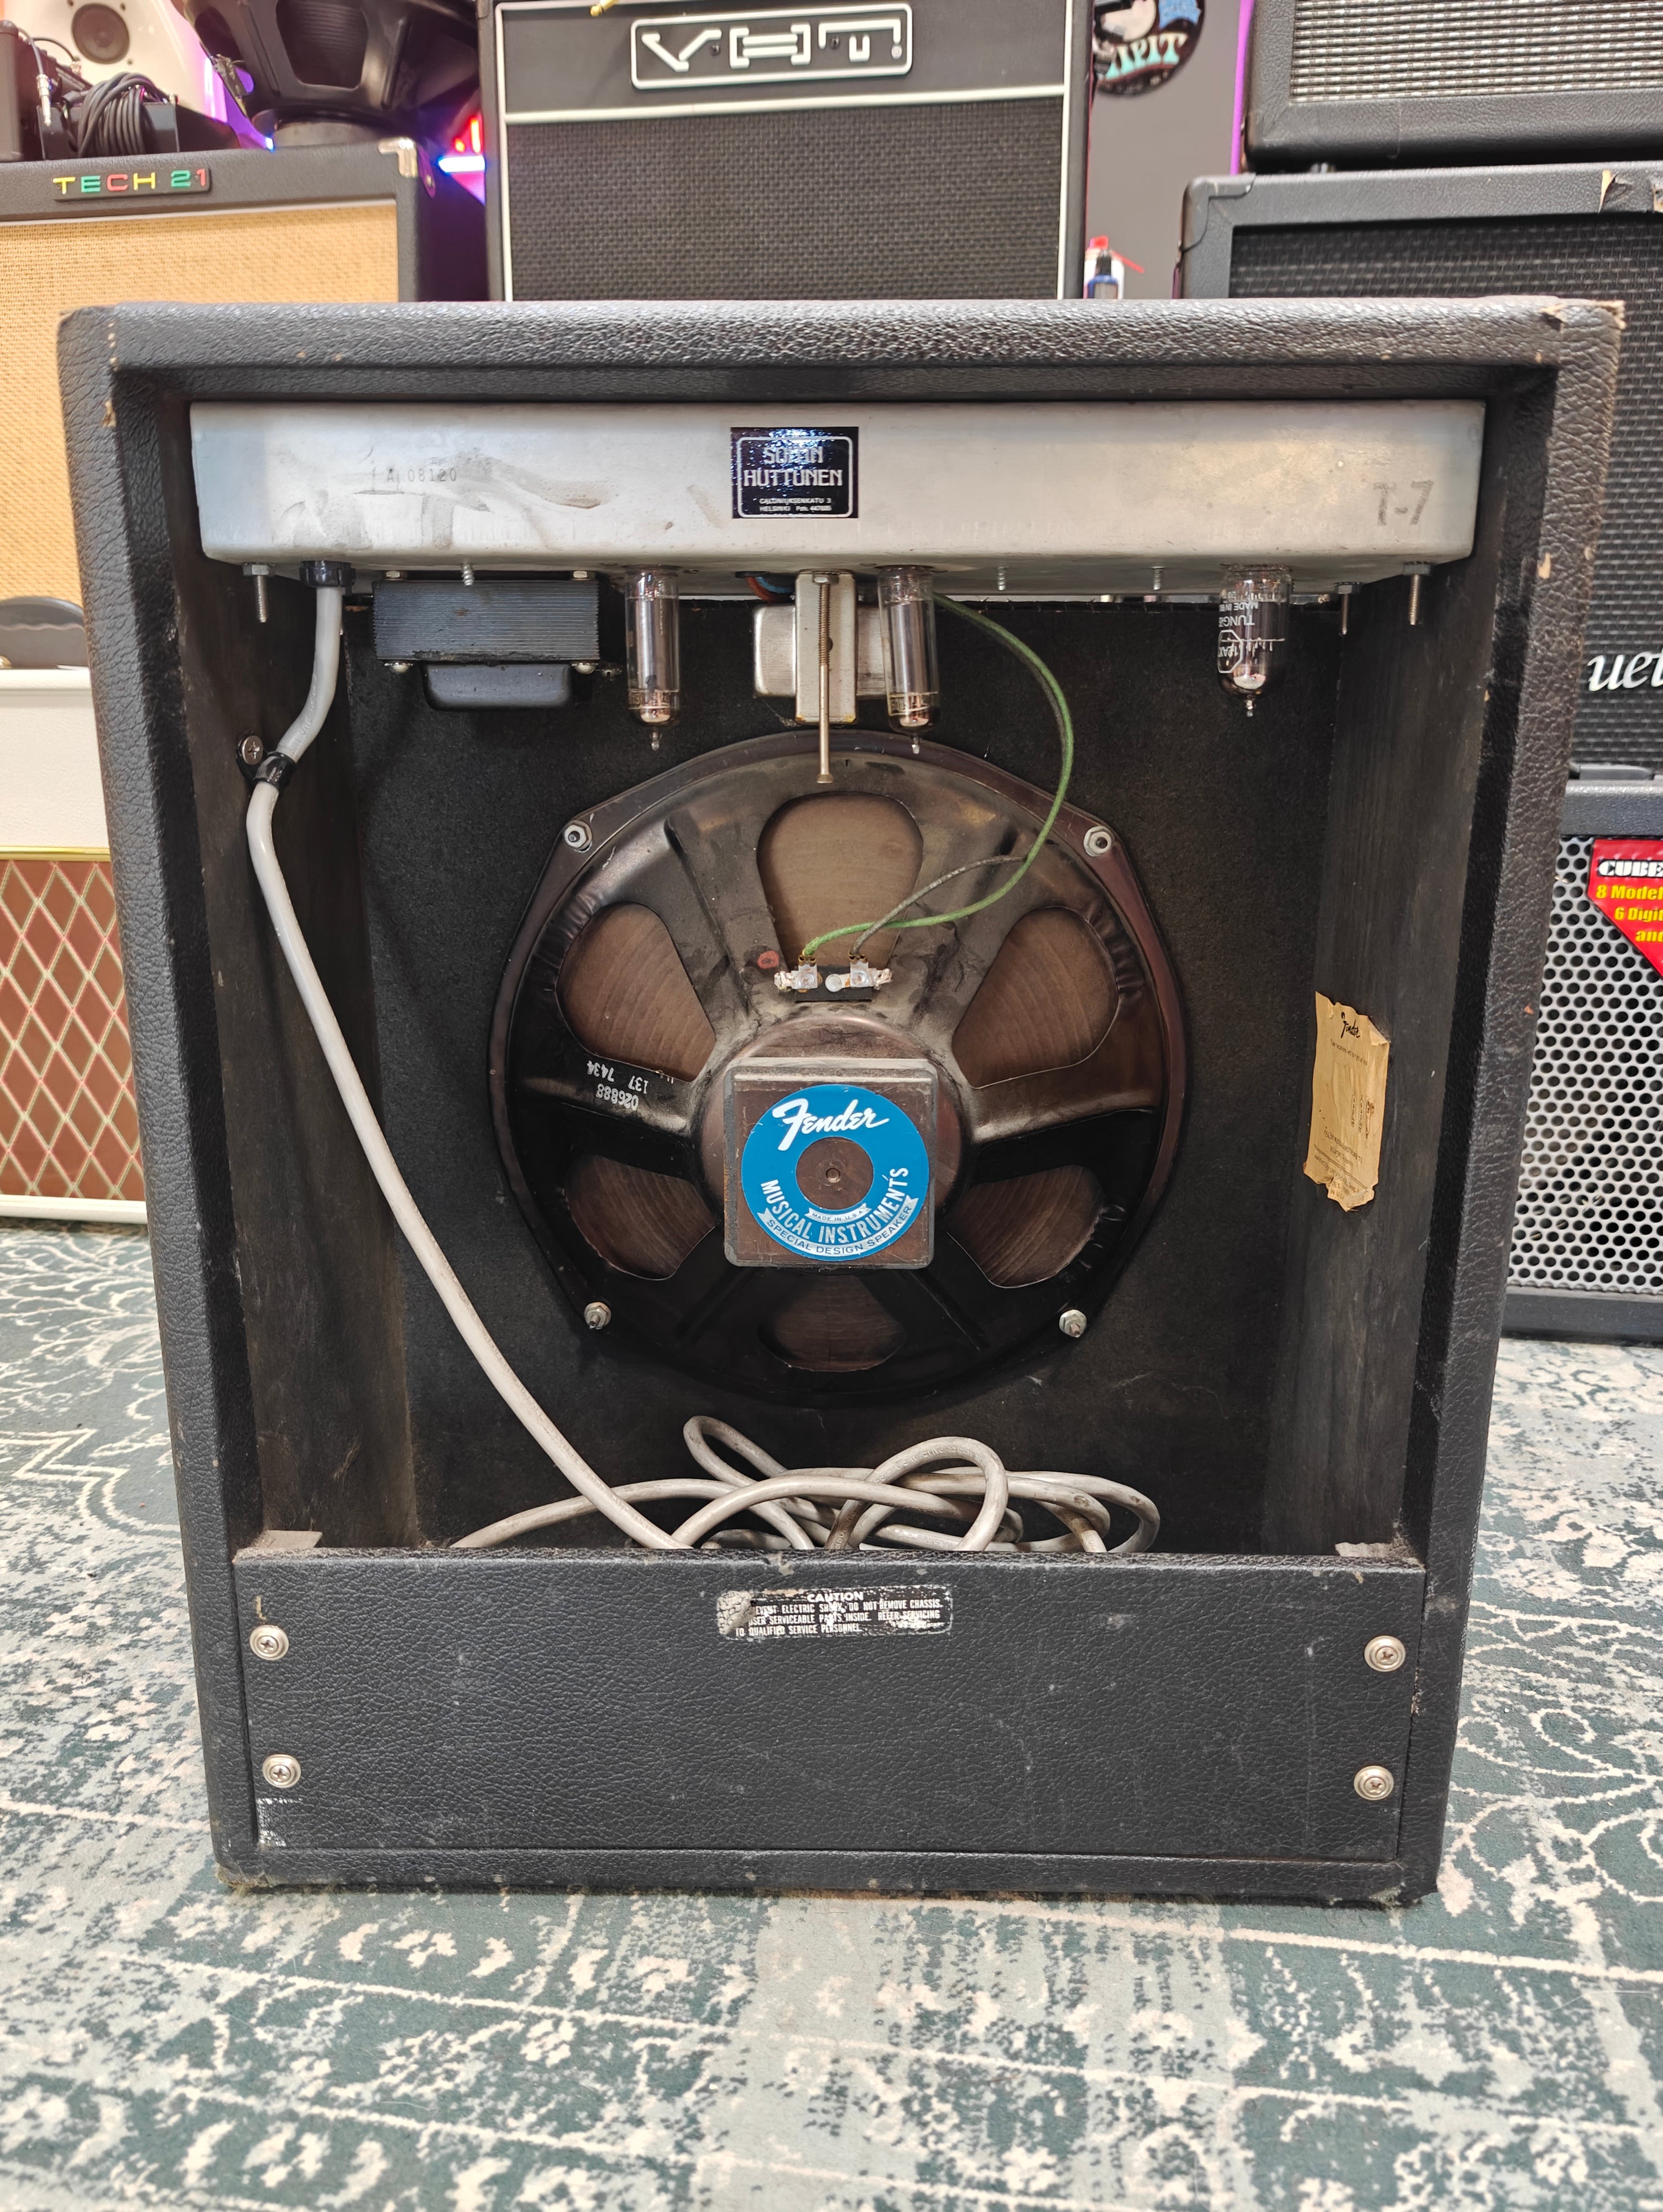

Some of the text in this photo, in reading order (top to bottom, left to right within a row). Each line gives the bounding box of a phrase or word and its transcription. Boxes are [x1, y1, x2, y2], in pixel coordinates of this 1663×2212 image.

[53, 168, 206, 195] TECH 21
[407, 468, 457, 482] 08120
[1234, 601, 1258, 611] MADE
[1598, 860, 1663, 877] CUBE
[1596, 885, 1663, 900] 8 Model
[1614, 907, 1625, 920] 6
[587, 1060, 649, 1094] 137 7434
[596, 1083, 639, 1110] 026888
[772, 1098, 889, 1151] Fender
[761, 1167, 909, 1244] MUSICAL INSTRUMENTS
[812, 1212, 831, 1222] MADE
[767, 1206, 912, 1255] SPECIAL DESIGN SPEAKER
[807, 1591, 864, 1603] CAUTION
[782, 1604, 815, 1614] ELECTRIC
[849, 1602, 859, 1611] DO
[863, 1601, 877, 1611] NOT
[880, 1600, 907, 1610] REMOVE
[769, 1614, 815, 1625] SERVICEABLE
[819, 1613, 842, 1623] PATS
[789, 1624, 818, 1634] SERVICE
